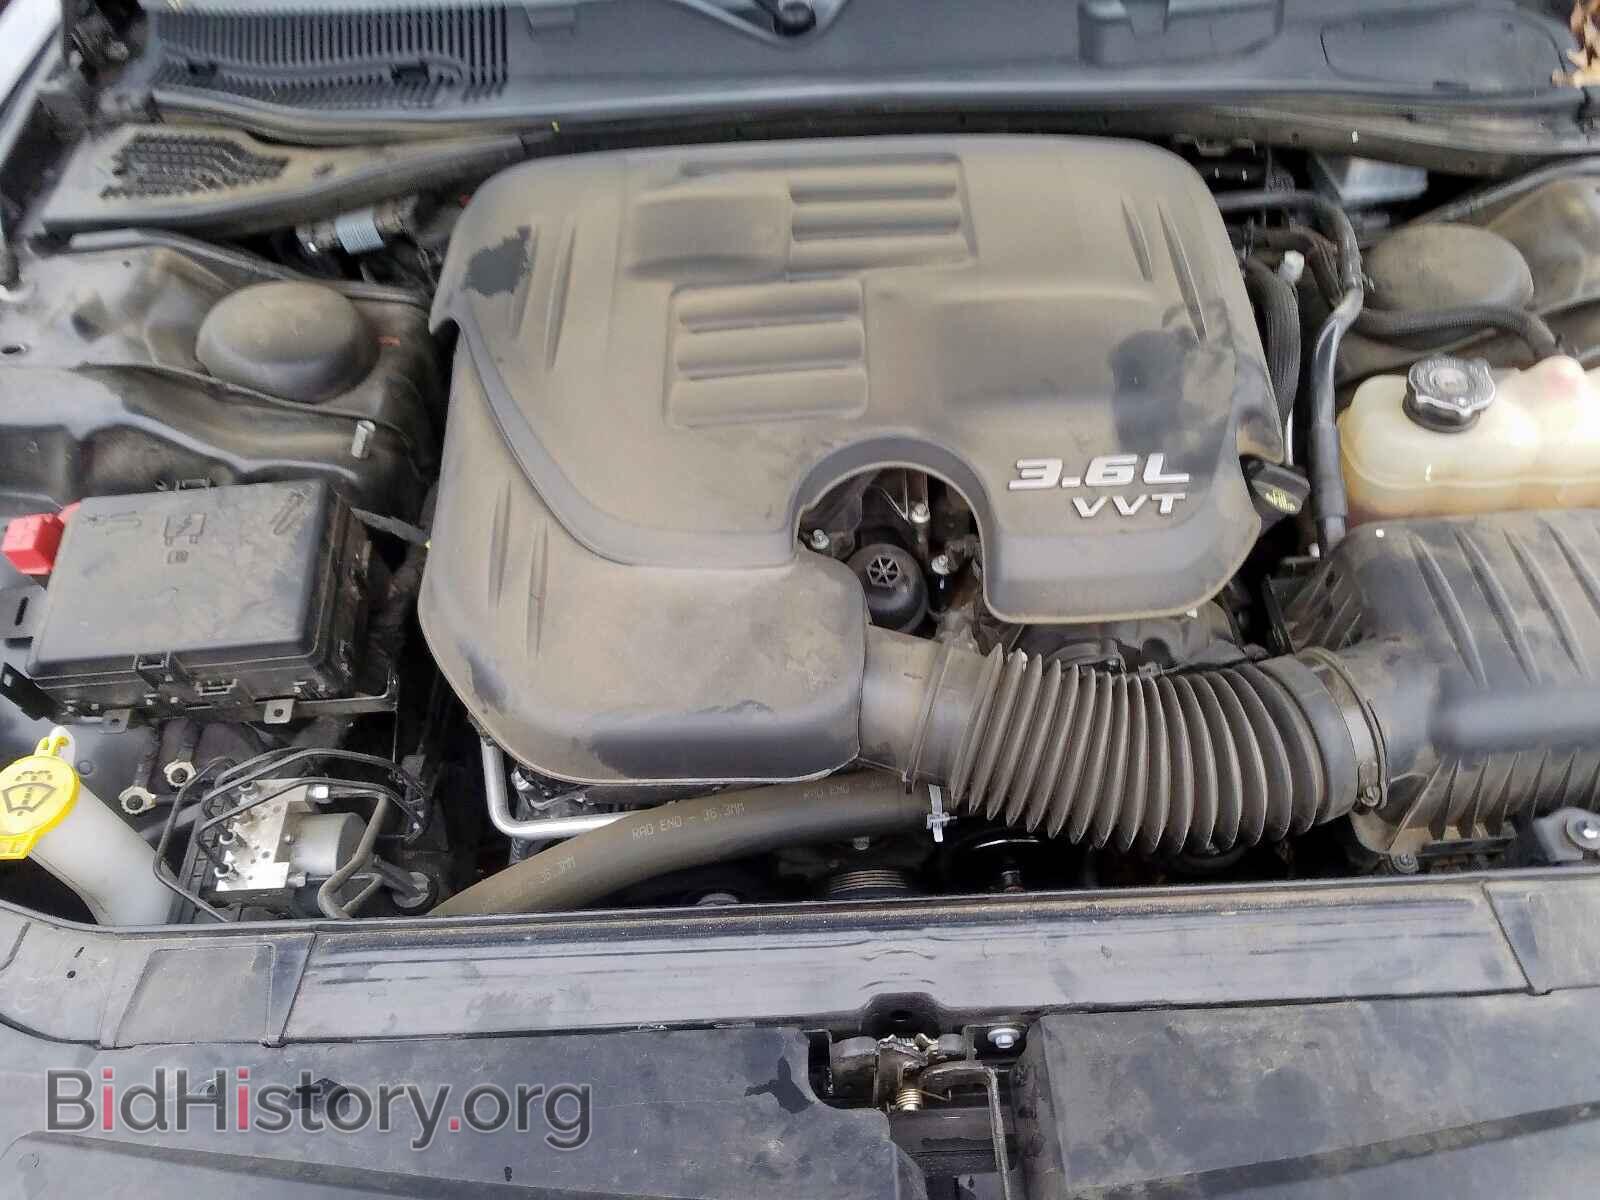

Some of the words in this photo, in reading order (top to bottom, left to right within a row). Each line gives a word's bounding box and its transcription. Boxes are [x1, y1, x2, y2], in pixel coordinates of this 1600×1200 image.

[1008, 453, 1190, 490] 3.6L
[1072, 493, 1186, 517] VVT
[631, 822, 655, 841] RAD
[659, 815, 682, 832] END
